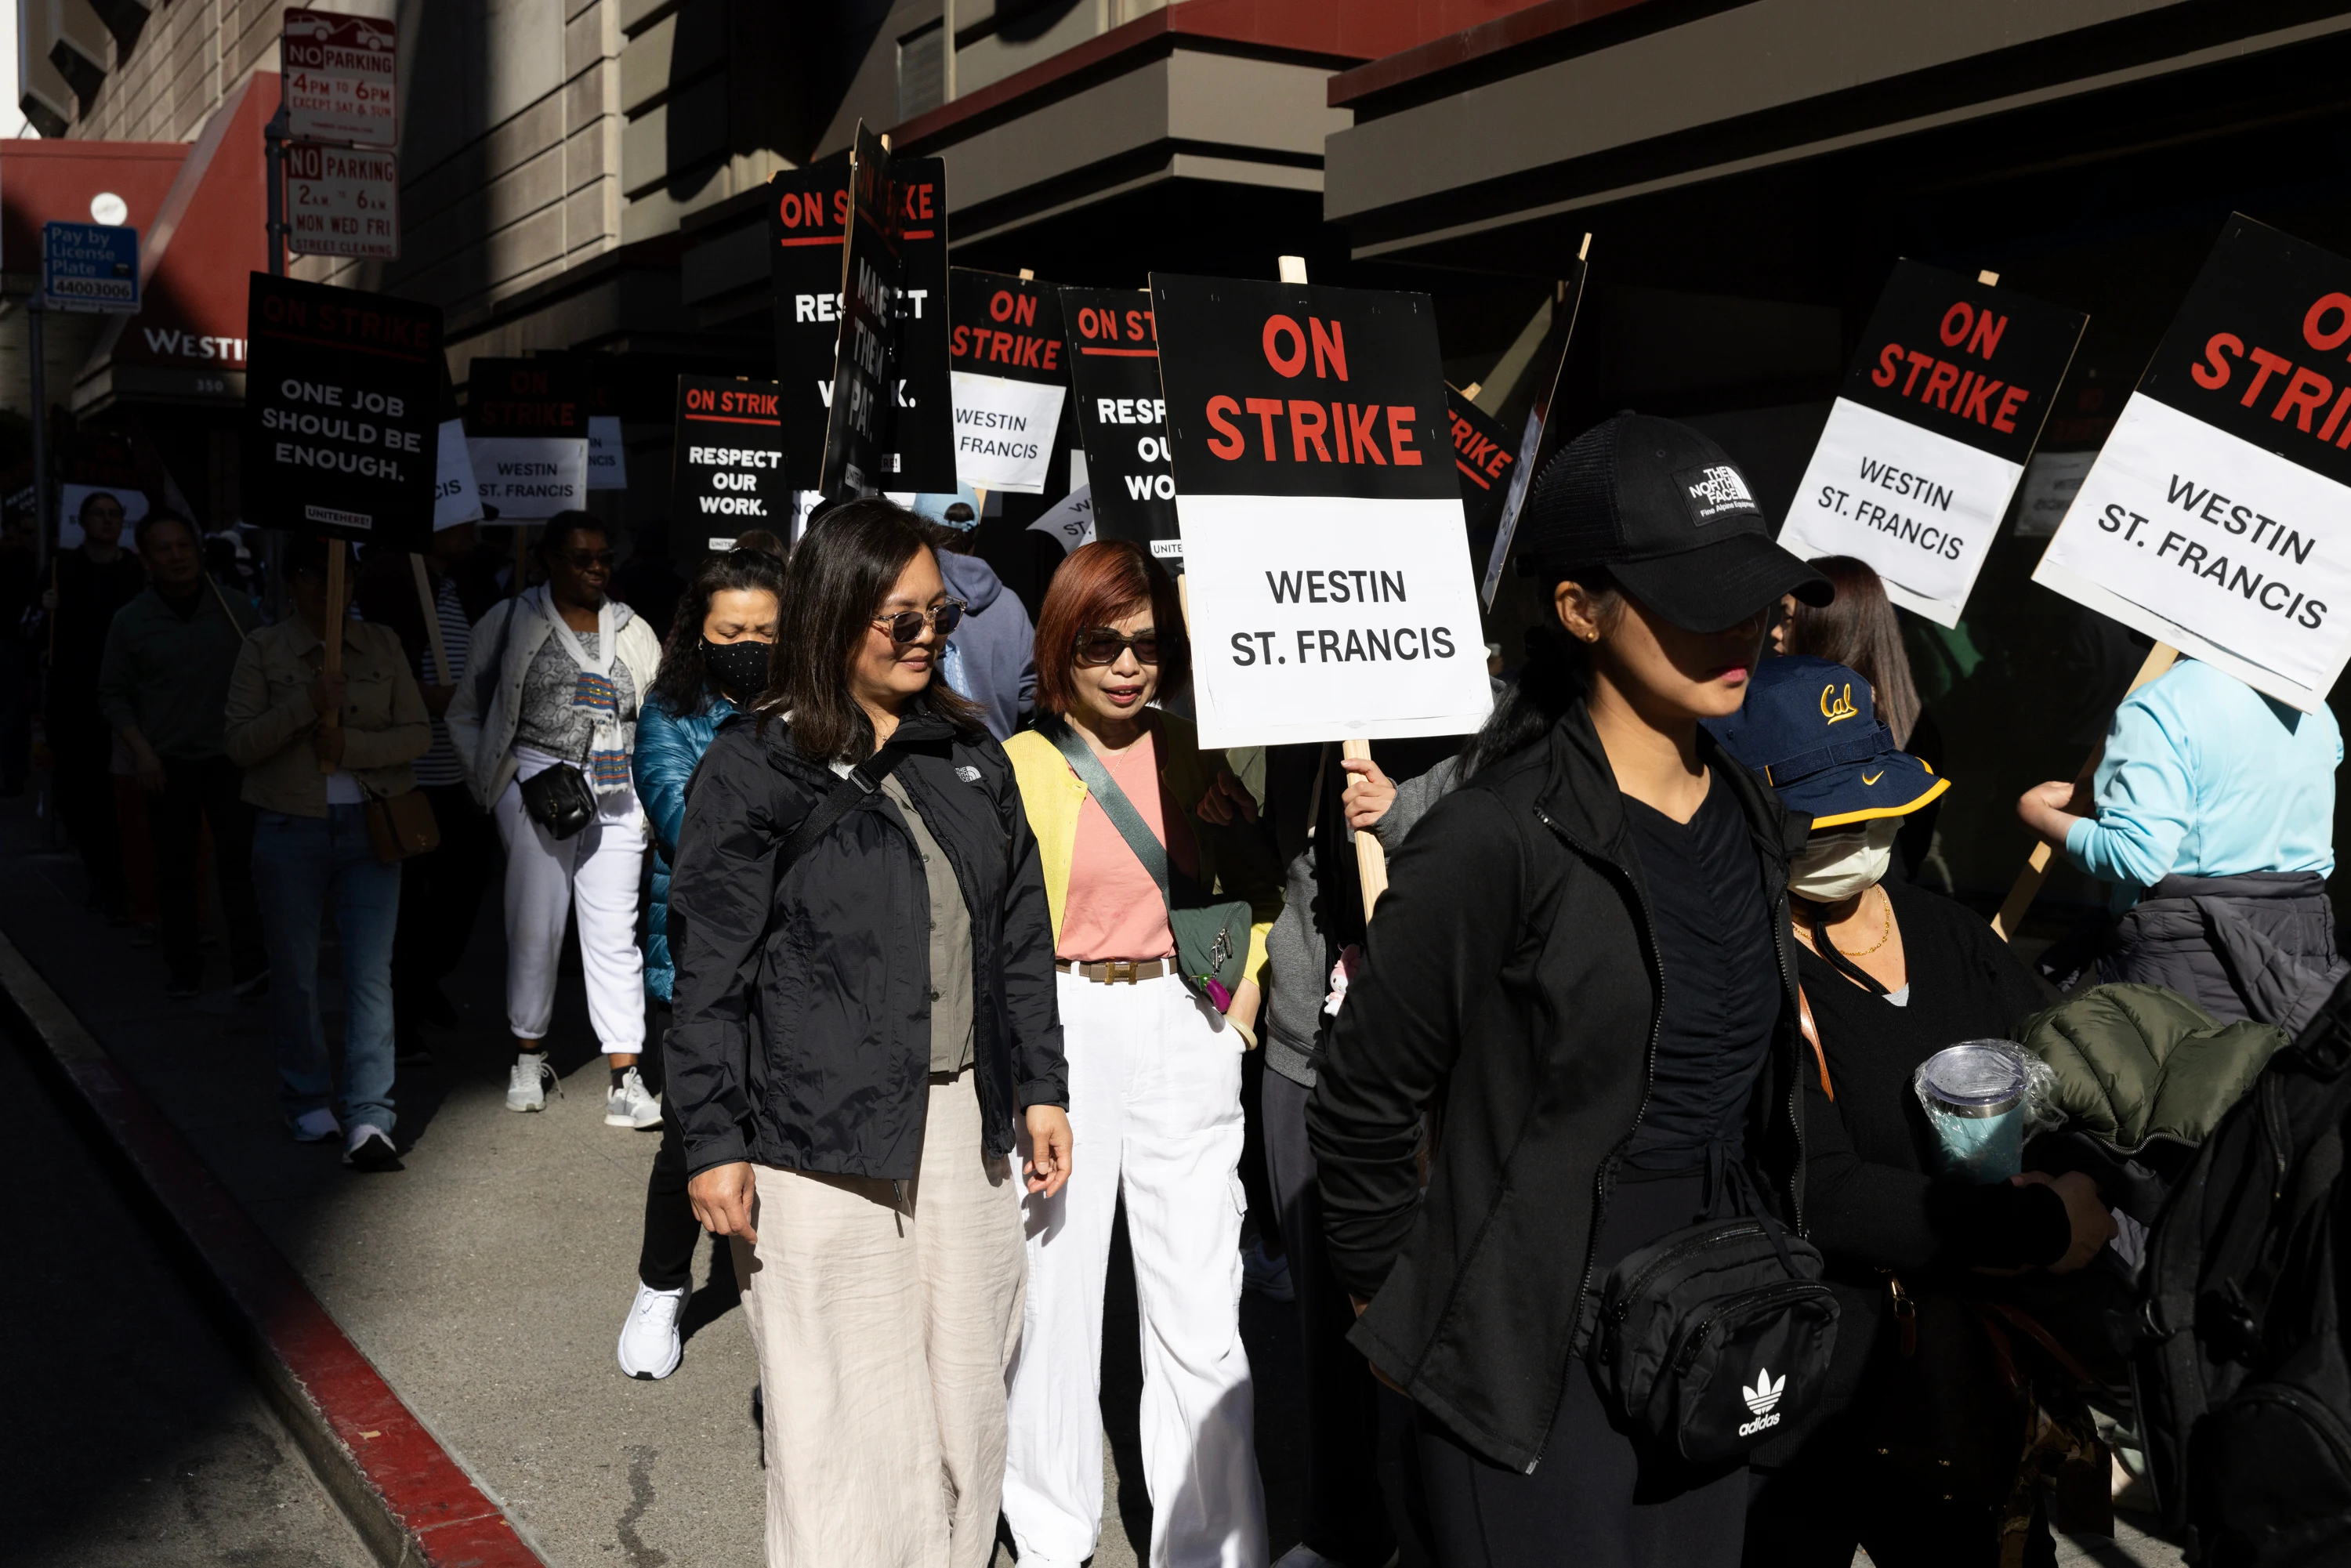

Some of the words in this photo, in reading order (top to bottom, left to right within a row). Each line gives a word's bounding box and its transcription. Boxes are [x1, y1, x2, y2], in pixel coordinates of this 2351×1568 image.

[289, 44, 322, 65] NO
[326, 50, 392, 73] PARKING
[335, 82, 349, 92] TO
[293, 96, 331, 110] EXCEPT
[335, 101, 353, 114] SAT
[371, 105, 391, 117] SUN
[290, 147, 320, 177] NO
[327, 157, 393, 182] PARKING
[780, 191, 824, 228] ON
[51, 226, 83, 247] Pay
[88, 228, 111, 249] by
[296, 214, 324, 232] MON
[330, 216, 359, 234] WED
[366, 219, 390, 236] FRI
[52, 242, 115, 263] License
[295, 238, 335, 251] STREET
[339, 241, 393, 255] CLEANING
[52, 259, 96, 277] Plate
[56, 281, 130, 298] 44003006
[262, 292, 306, 328] ON
[317, 302, 430, 350] STRIKE
[990, 289, 1038, 328] ON
[1078, 307, 1118, 341] ON
[1940, 301, 2009, 361] ON
[2302, 292, 2351, 363] O
[853, 316, 884, 385] THEM
[951, 324, 1062, 371] STRIKE
[1262, 313, 1349, 382] ON
[510, 370, 549, 395] ON
[1871, 342, 2030, 436] STRIKE
[2190, 331, 2351, 451] STRI
[281, 378, 343, 407] ONE
[351, 389, 404, 418] JOB
[686, 389, 715, 411] ON
[720, 391, 779, 416] STRIK
[1097, 398, 1166, 424] RESP
[481, 402, 576, 427] STRIKE
[955, 408, 1027, 432] WESTIN
[261, 407, 378, 444] SHOULD
[384, 428, 422, 454] BE
[1205, 394, 1423, 466] STRIKE
[960, 436, 1038, 458] FRANCIS
[1138, 436, 1171, 462] OU
[1448, 408, 1513, 480] RIKE
[275, 442, 405, 483] ENOUGH.
[498, 463, 557, 476] WESTIN
[589, 455, 616, 466] NCIS
[689, 446, 782, 469] RESPECT
[712, 473, 757, 491] OUR
[1703, 466, 1729, 480] THE
[1860, 456, 1954, 512] WESTIN
[479, 484, 500, 497] ST.
[505, 484, 574, 497] FRANCIS
[1689, 476, 1733, 498] NORTH
[1707, 487, 1739, 505] FACE
[699, 496, 768, 516] WORK.
[1701, 508, 1715, 517] Fine
[1716, 502, 1734, 512] Alpine
[1818, 486, 1849, 516] ST.
[1855, 501, 1964, 560] FRANCIS
[2167, 474, 2316, 565] WESTIN
[1154, 545, 1182, 553] UNITE
[2098, 504, 2149, 548] ST.
[2157, 531, 2327, 630] FRANCIS
[1266, 570, 1407, 604] WESTIN
[1230, 632, 1285, 667] ST.
[1297, 626, 1456, 664] FRANCIS
[1820, 683, 1858, 725] Cal
[1739, 1413, 1780, 1436] adidas
